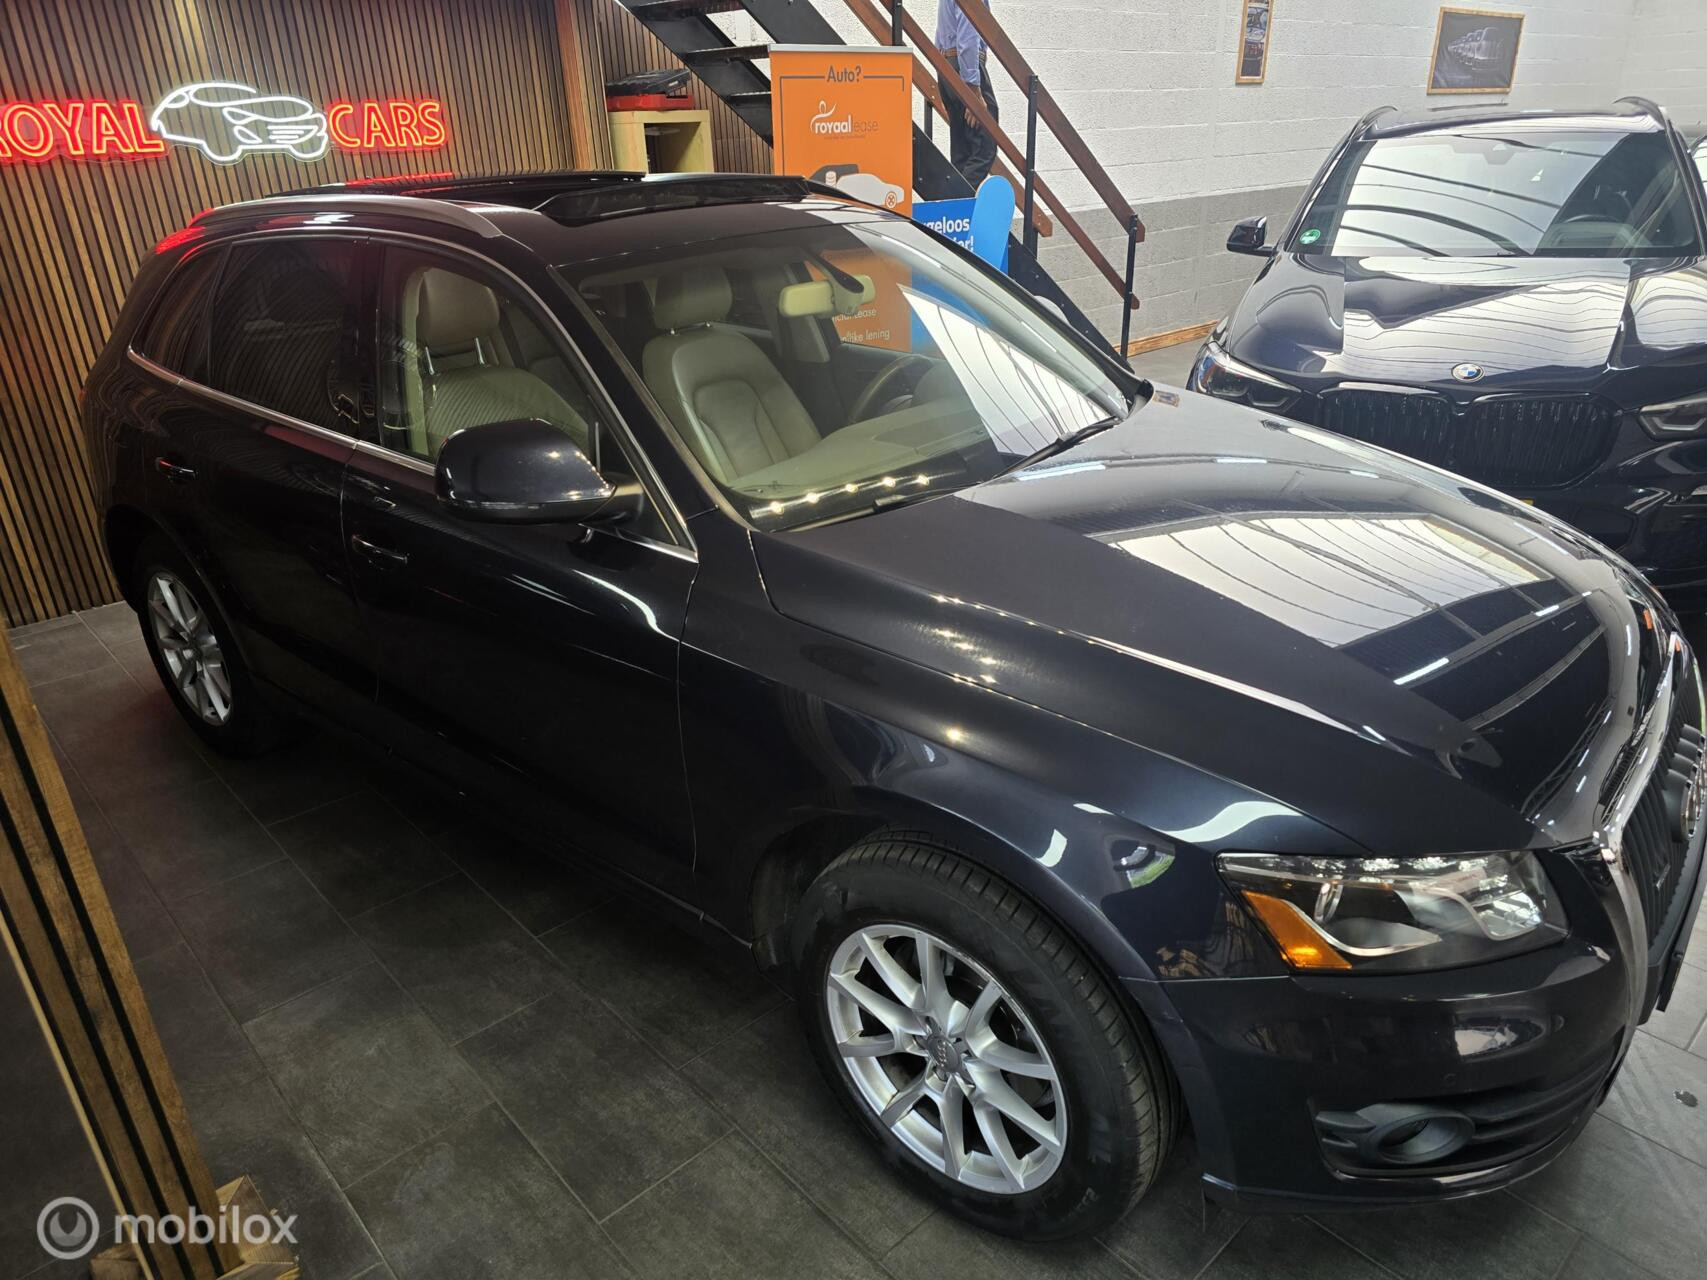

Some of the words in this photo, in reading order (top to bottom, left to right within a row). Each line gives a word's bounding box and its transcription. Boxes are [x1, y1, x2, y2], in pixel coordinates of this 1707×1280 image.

[826, 65, 862, 83] Auto?
[0, 103, 165, 157] OYAL
[330, 101, 446, 148] CARS
